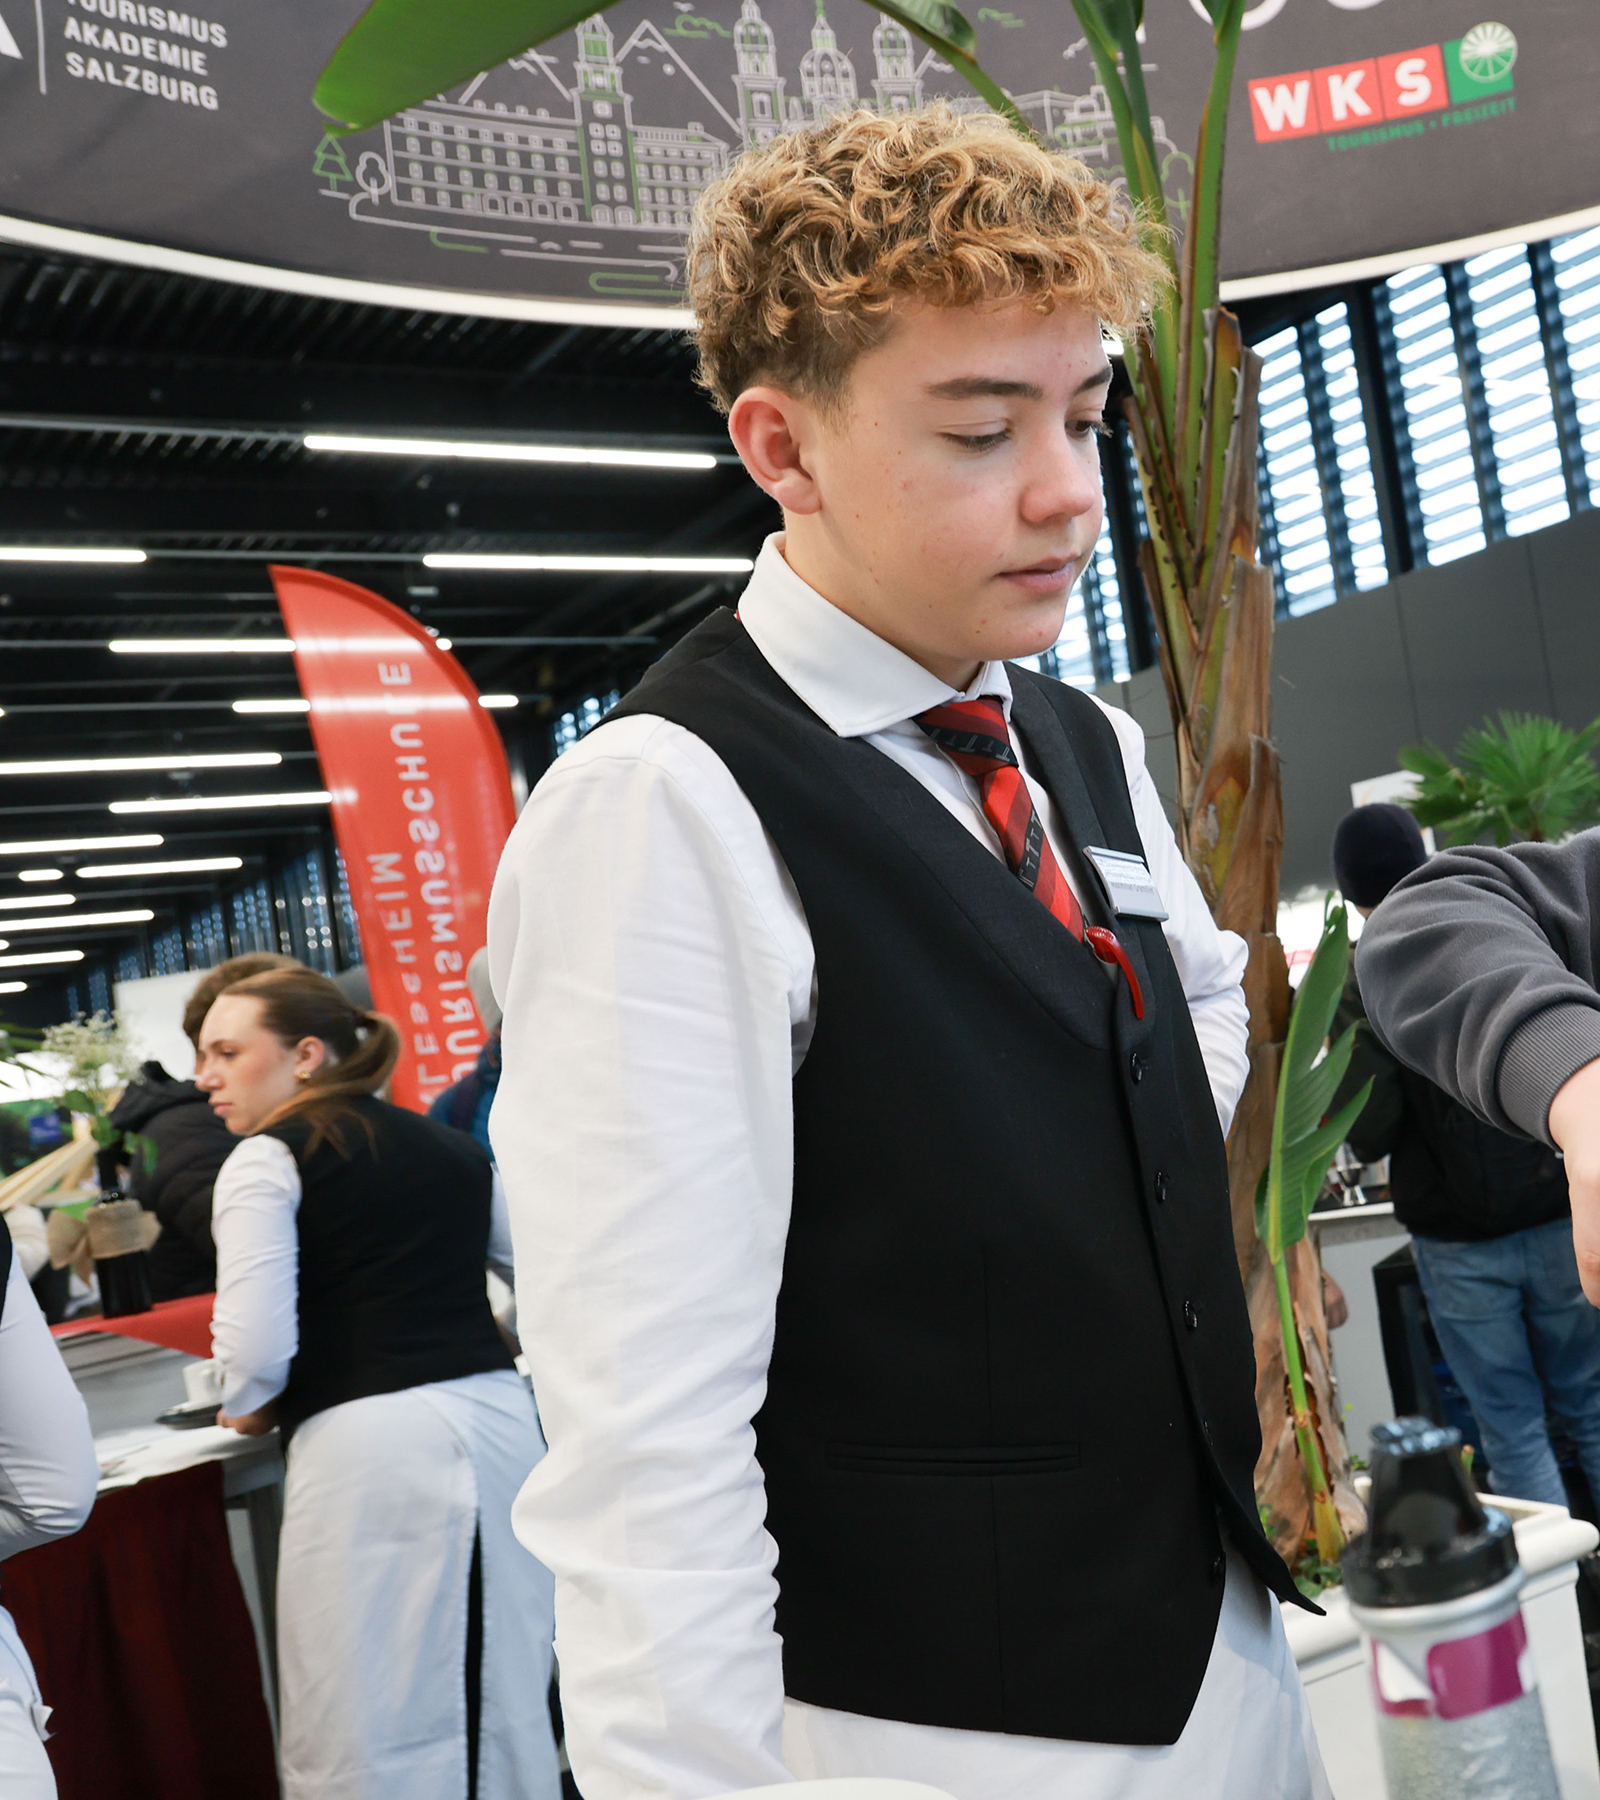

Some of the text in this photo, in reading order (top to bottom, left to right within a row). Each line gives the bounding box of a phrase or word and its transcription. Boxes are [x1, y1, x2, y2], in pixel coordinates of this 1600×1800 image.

[63, 16, 209, 77] AKADEMIE
[67, 0, 228, 48] OURISMUS
[65, 51, 220, 111] SALZBURG
[1253, 57, 1432, 132] WKS
